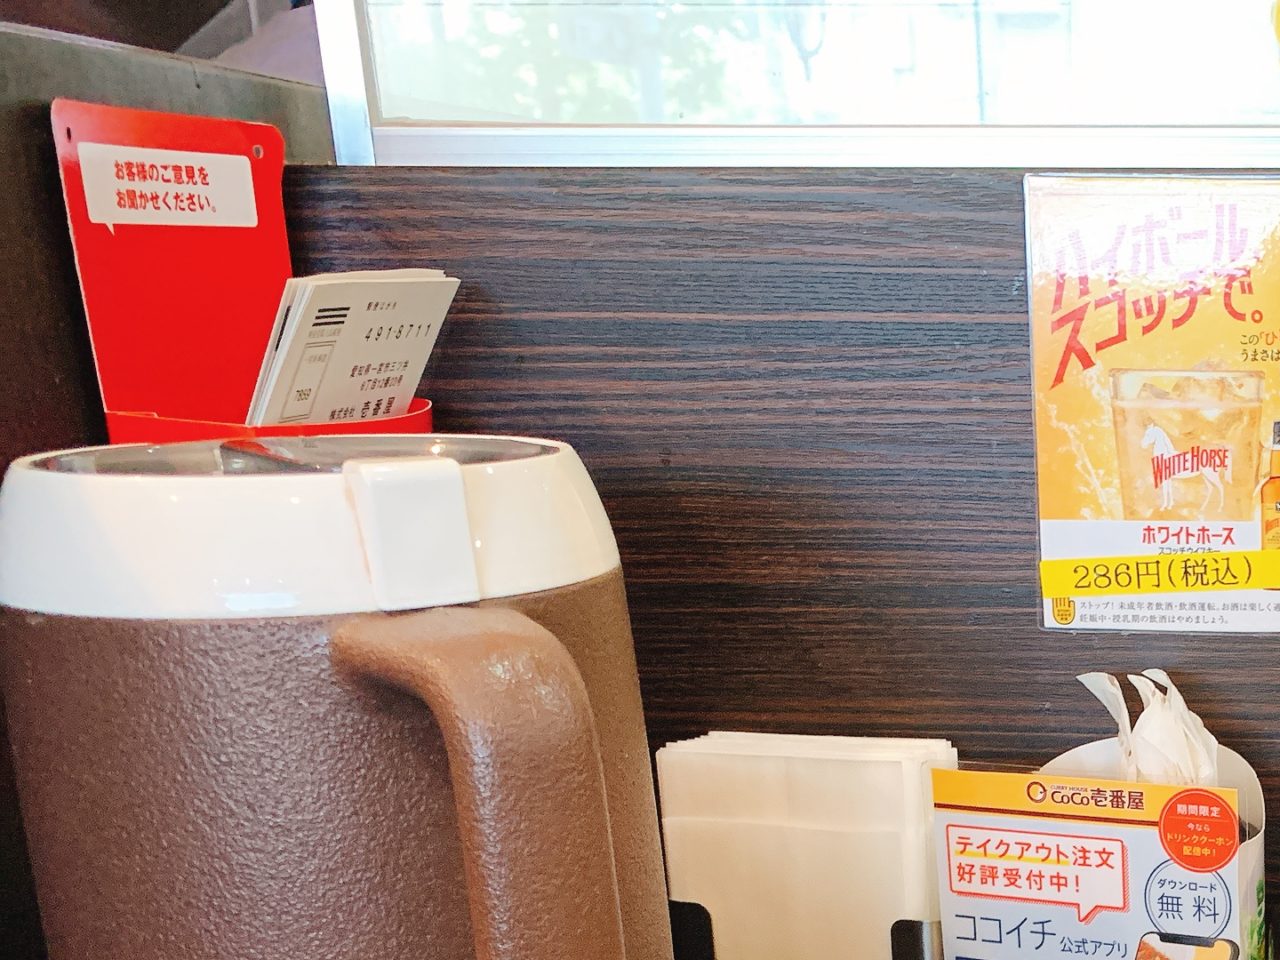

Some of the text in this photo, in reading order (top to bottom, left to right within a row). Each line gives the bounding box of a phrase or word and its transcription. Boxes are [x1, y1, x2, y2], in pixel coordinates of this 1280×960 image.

[113, 160, 210, 186] お客様のご意見を
[116, 189, 217, 213] お聞かせください。
[1142, 525, 1236, 545] ホワイトホース
[1050, 788, 1145, 811] CoCo壱番屋
[1176, 803, 1222, 818] 期間限定
[954, 835, 1116, 870] テイクアウト注文
[956, 862, 1081, 893] 好評受付中!
[1156, 878, 1218, 893] ダウンロード
[1156, 893, 1220, 924] 無料
[954, 913, 1128, 958] ココイチ 公式アプリ
